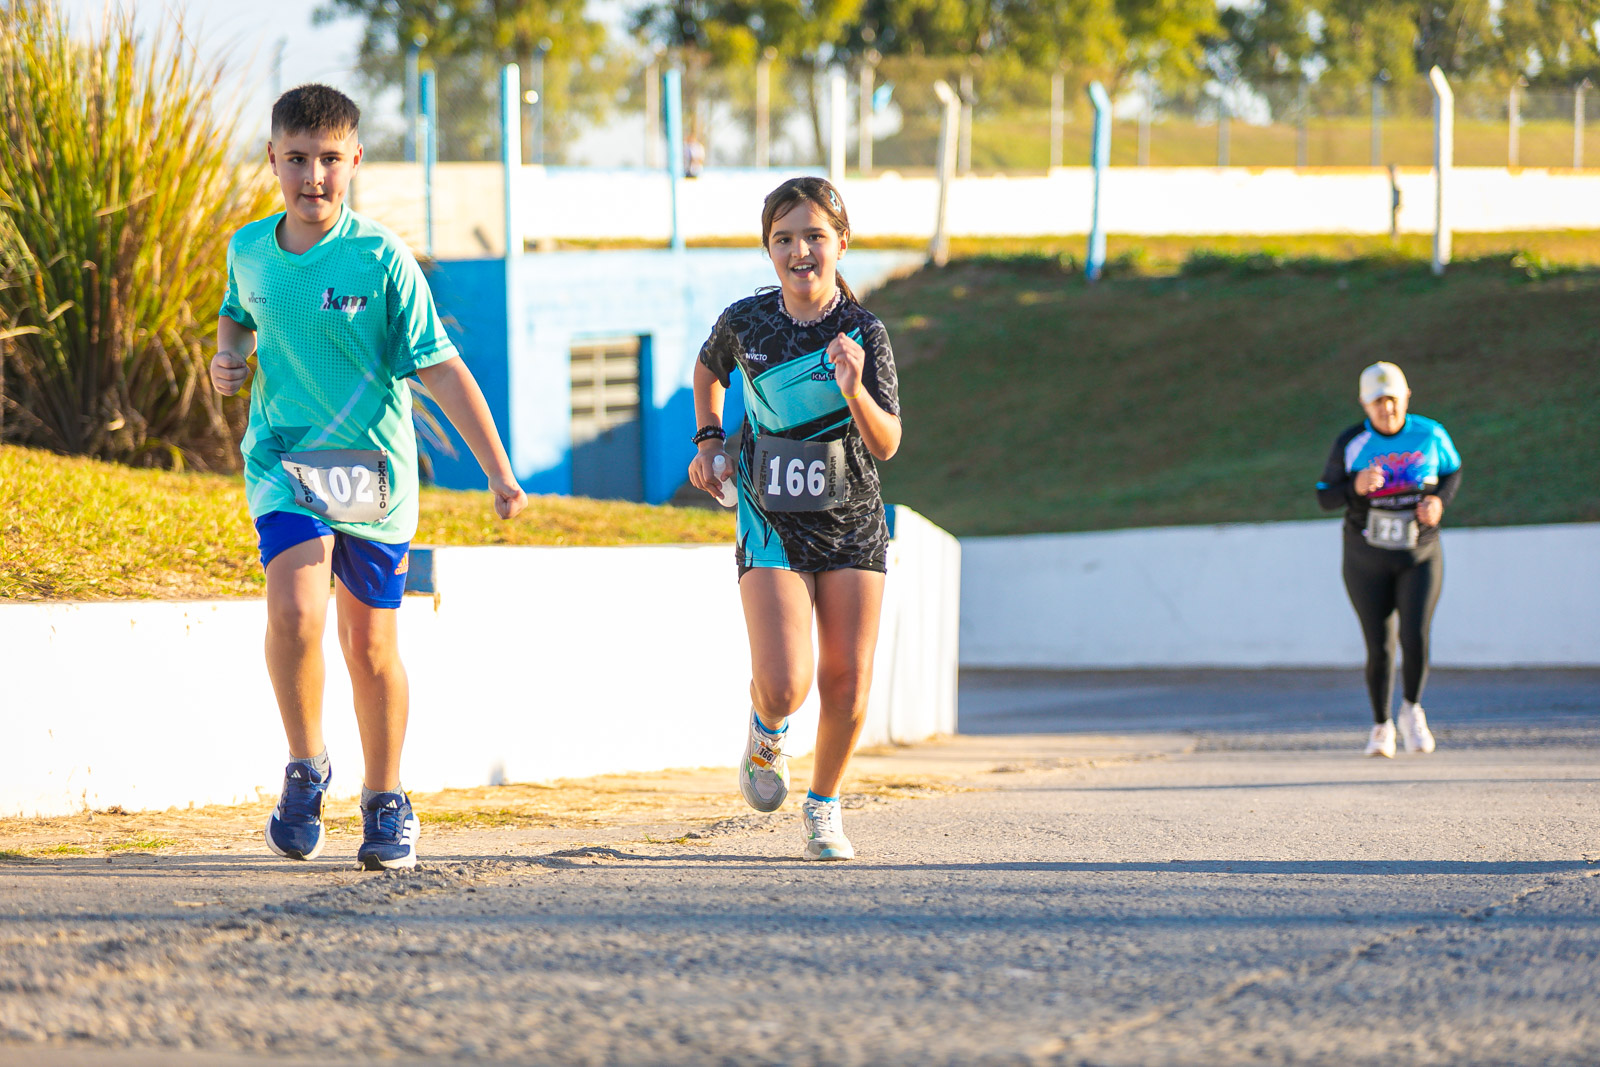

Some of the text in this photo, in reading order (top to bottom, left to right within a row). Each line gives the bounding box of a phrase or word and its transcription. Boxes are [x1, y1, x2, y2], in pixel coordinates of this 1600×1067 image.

[811, 372, 826, 380] KM
[308, 464, 374, 503] 102
[377, 460, 387, 509] EXACTO
[761, 450, 769, 496] TIEMPO
[767, 455, 826, 497] 166
[828, 456, 837, 498] EXACTO
[759, 748, 773, 761] 166
